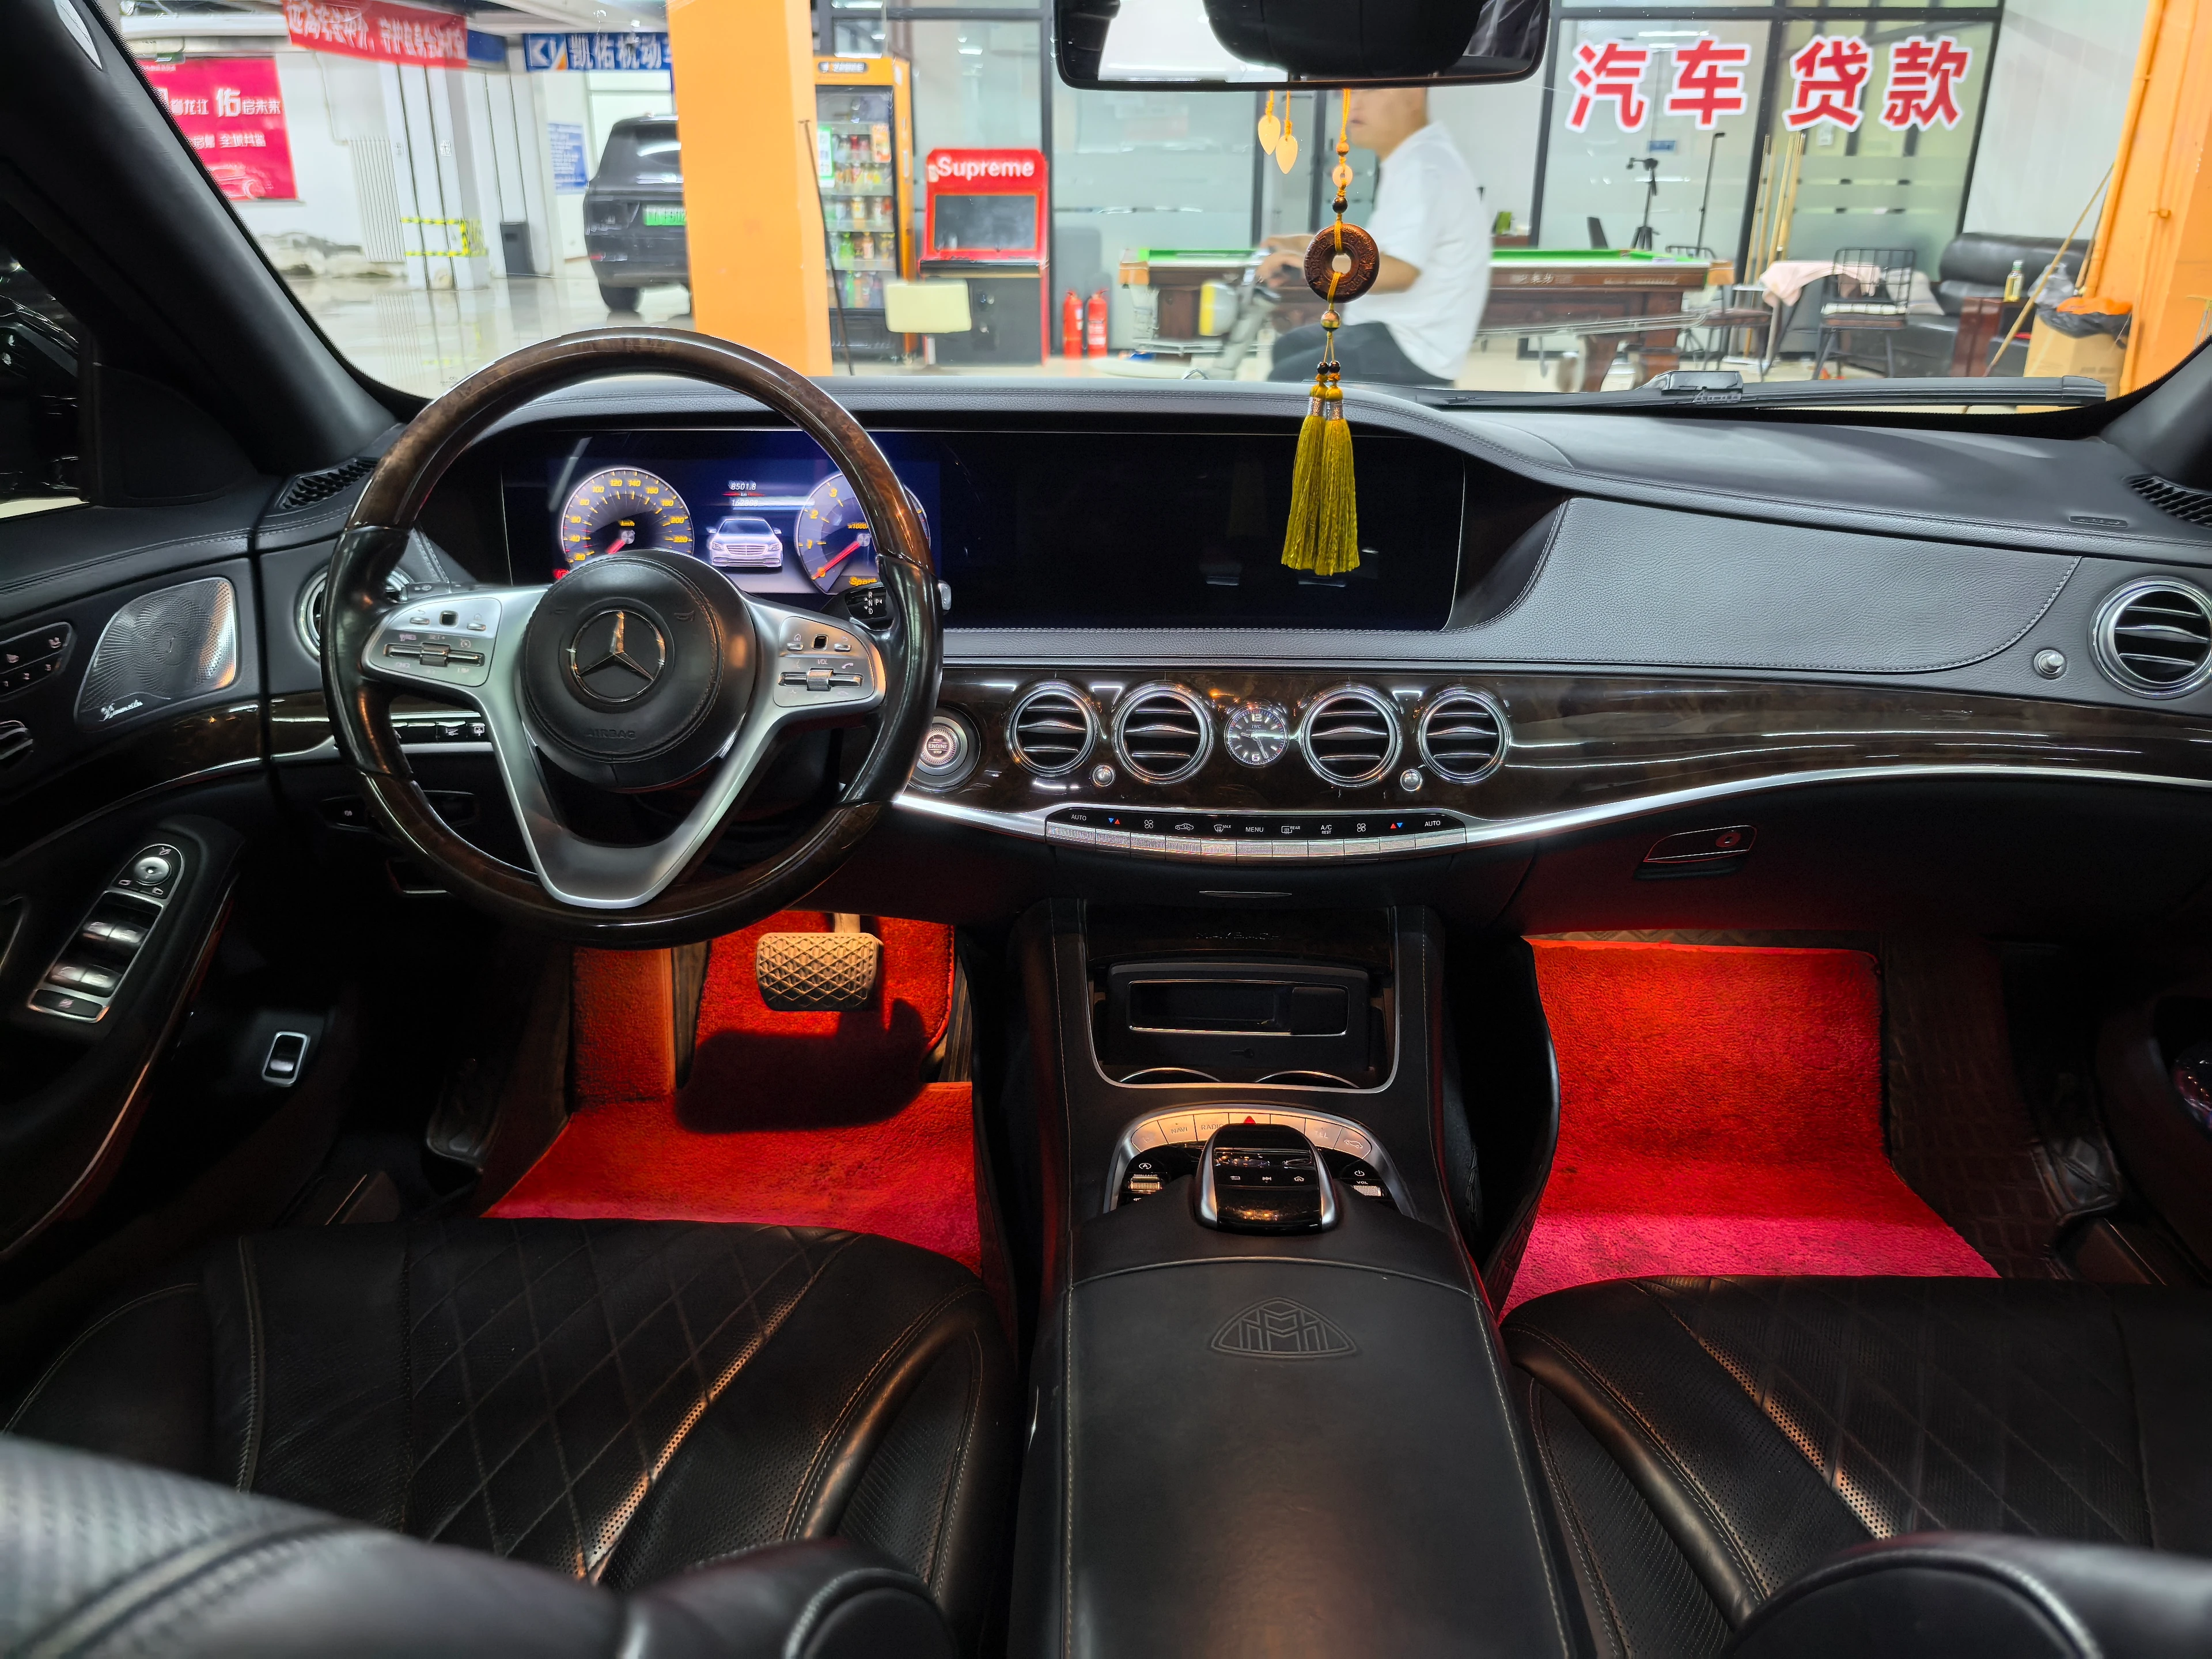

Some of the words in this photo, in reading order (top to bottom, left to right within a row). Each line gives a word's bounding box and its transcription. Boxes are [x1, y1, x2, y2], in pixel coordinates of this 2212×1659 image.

[1567, 37, 1971, 131] 汽车贷款
[937, 157, 1035, 181] Supreme
[829, 488, 837, 497] 3
[810, 510, 818, 518] 2
[808, 540, 812, 549] 1
[850, 577, 877, 586] Sport
[1252, 753, 1260, 762] 6
